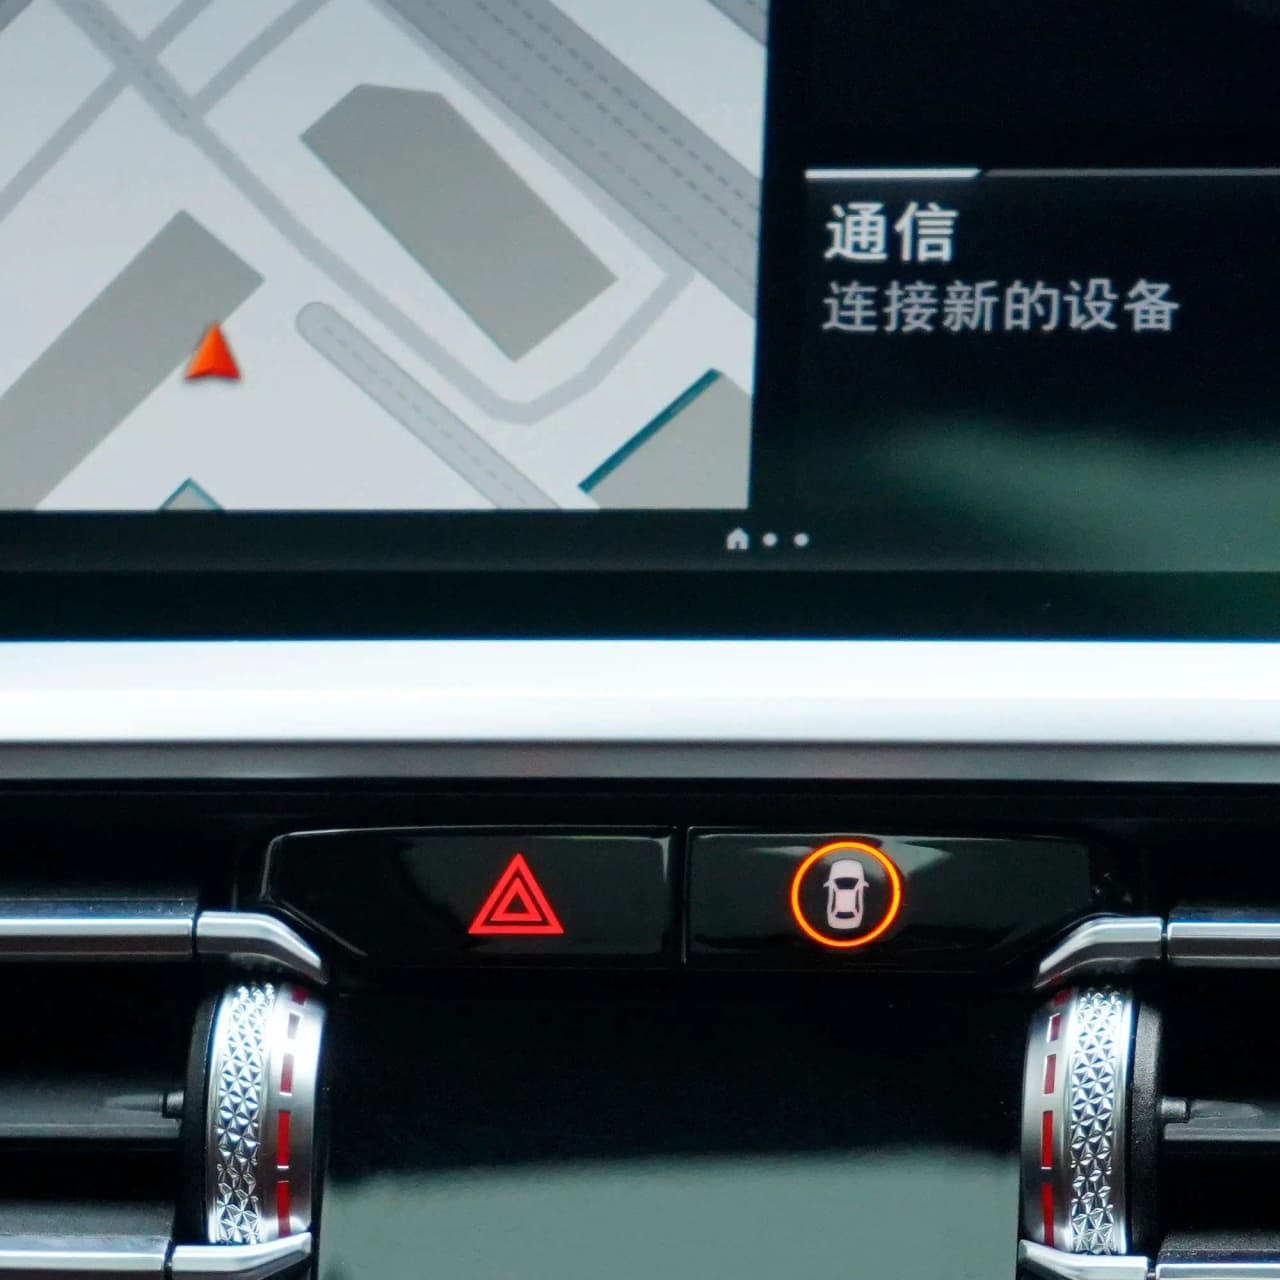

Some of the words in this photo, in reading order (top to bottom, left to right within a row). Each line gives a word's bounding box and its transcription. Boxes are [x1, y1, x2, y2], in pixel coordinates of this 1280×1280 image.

[823, 202, 959, 264] 通信
[821, 278, 1180, 332] 连接新的设备
